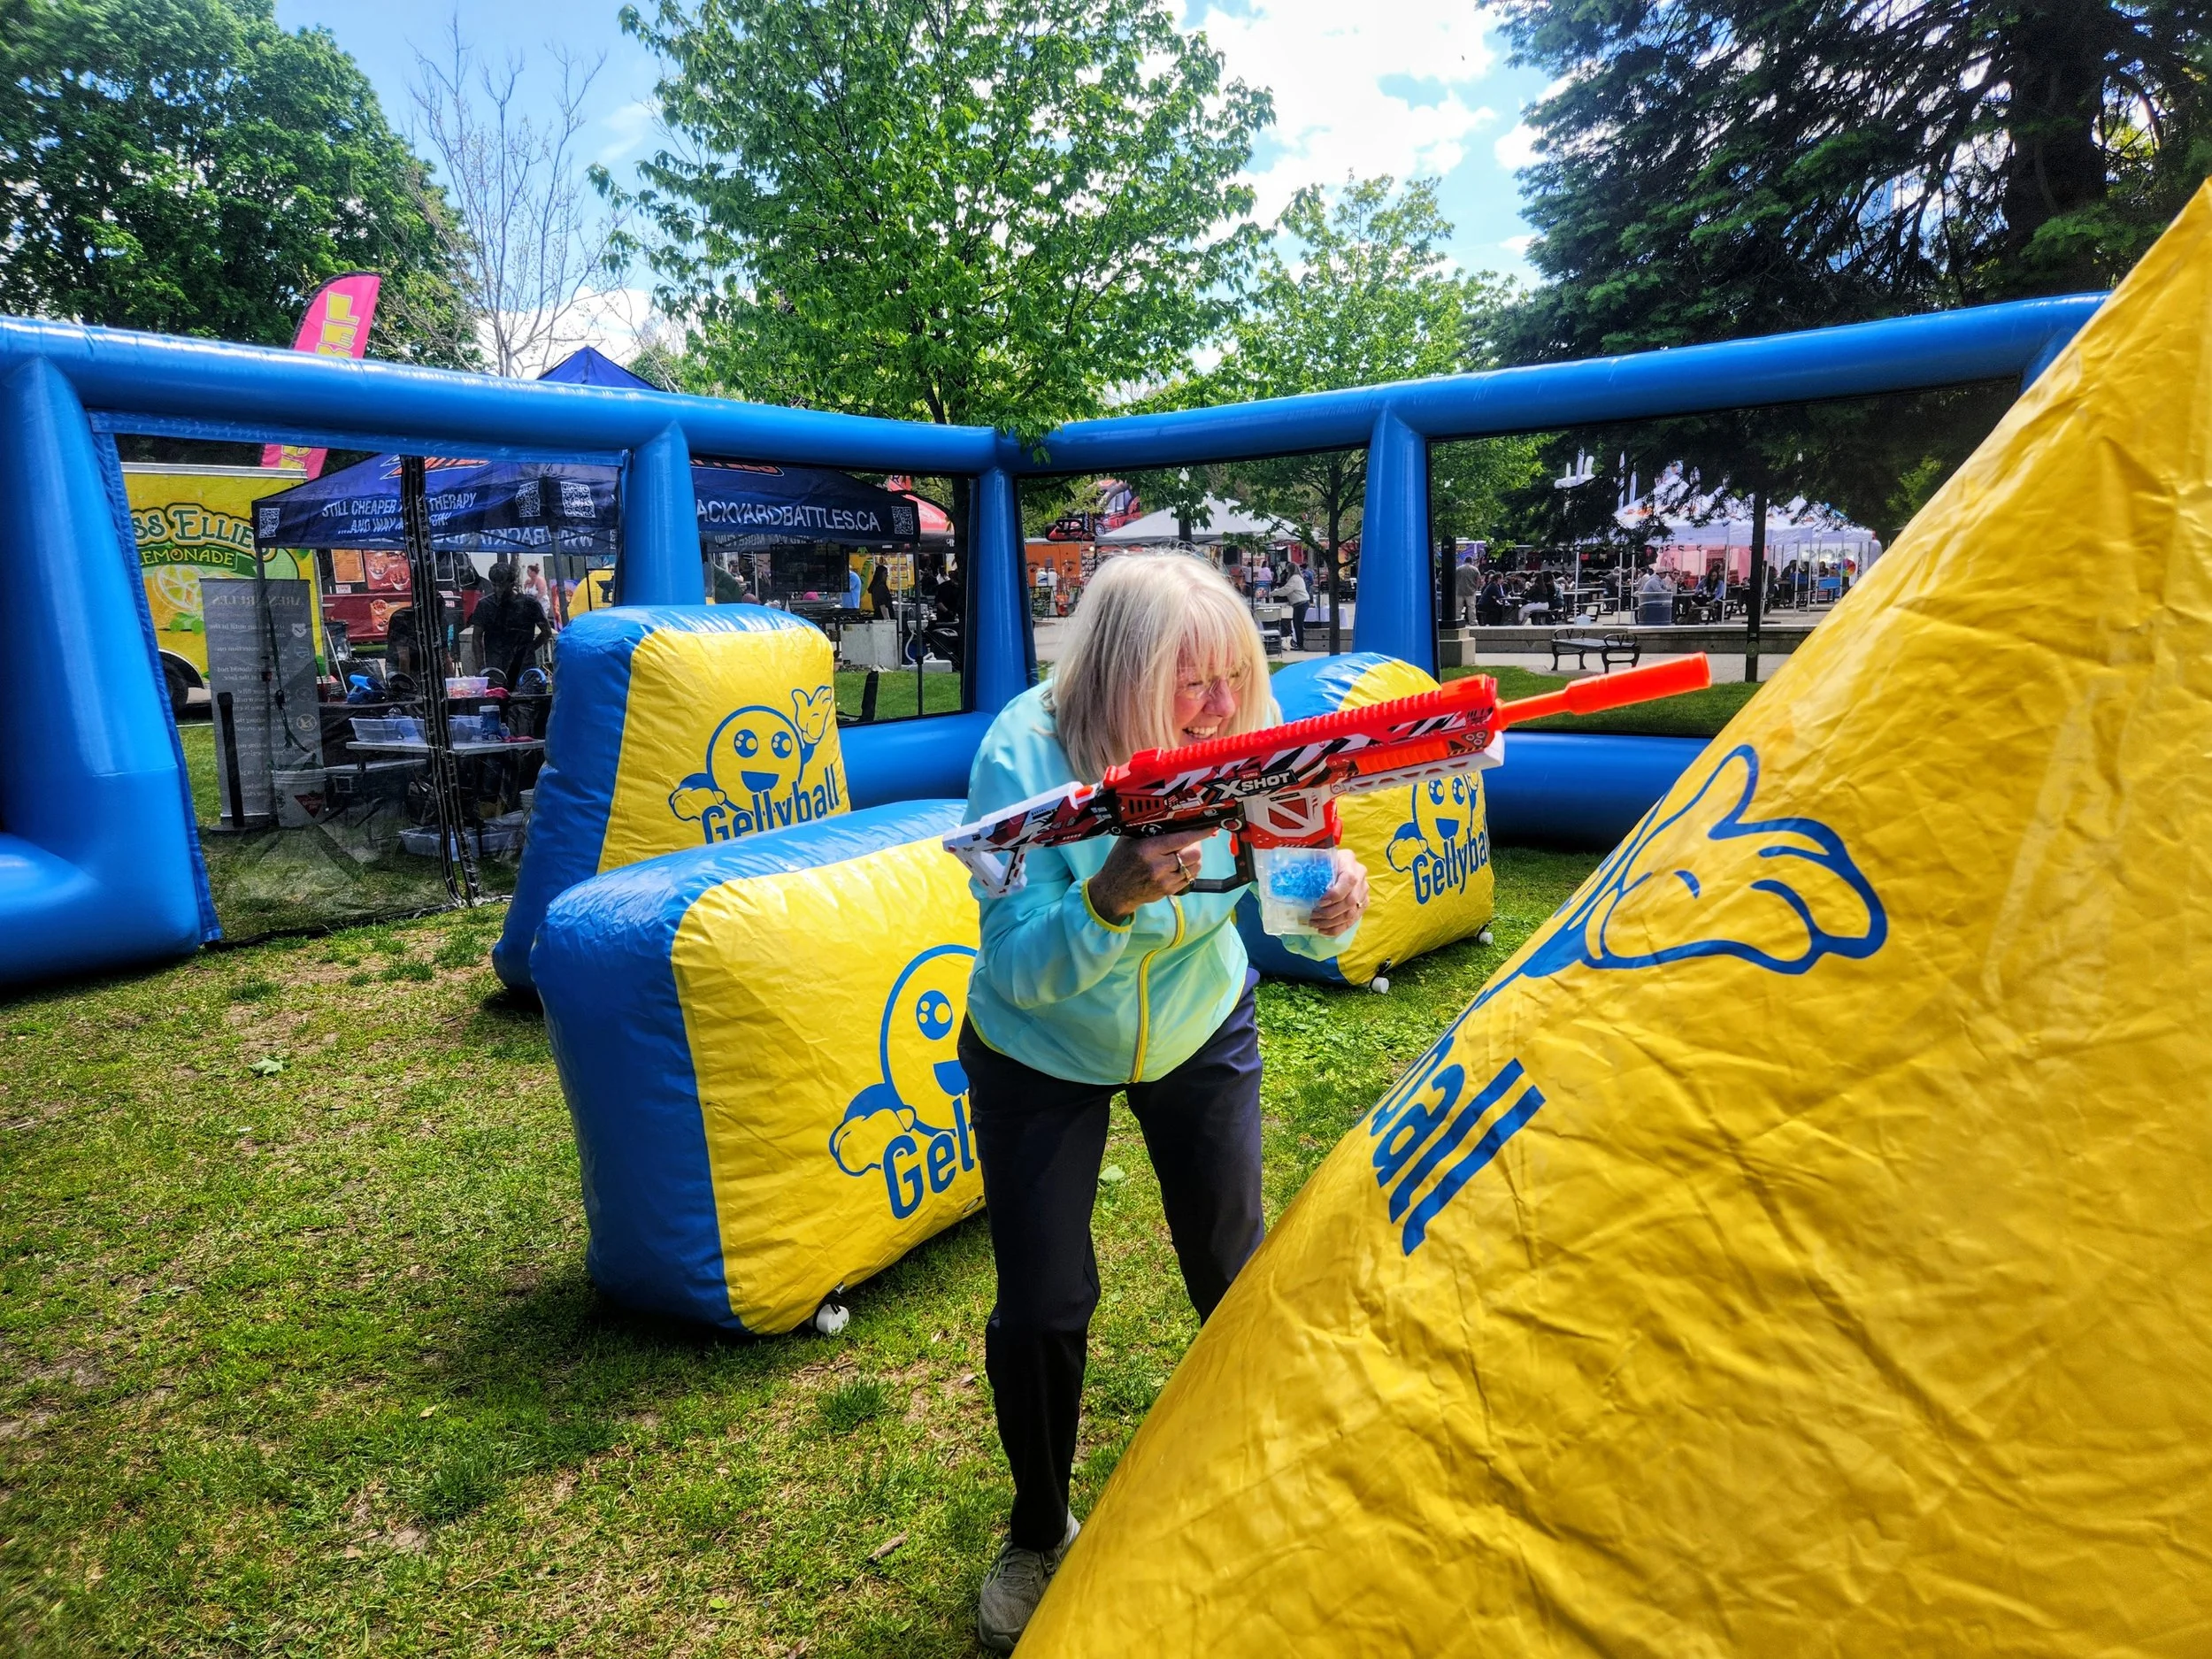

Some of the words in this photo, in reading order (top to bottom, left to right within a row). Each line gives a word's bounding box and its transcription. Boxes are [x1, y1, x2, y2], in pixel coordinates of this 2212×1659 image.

[322, 500, 349, 518] STILL
[352, 500, 397, 517] CHEAPER
[429, 493, 477, 511] THERAPY
[173, 510, 264, 552] ELLIE
[140, 548, 235, 566] EMONADE
[1412, 825, 1488, 904] Gellyba
